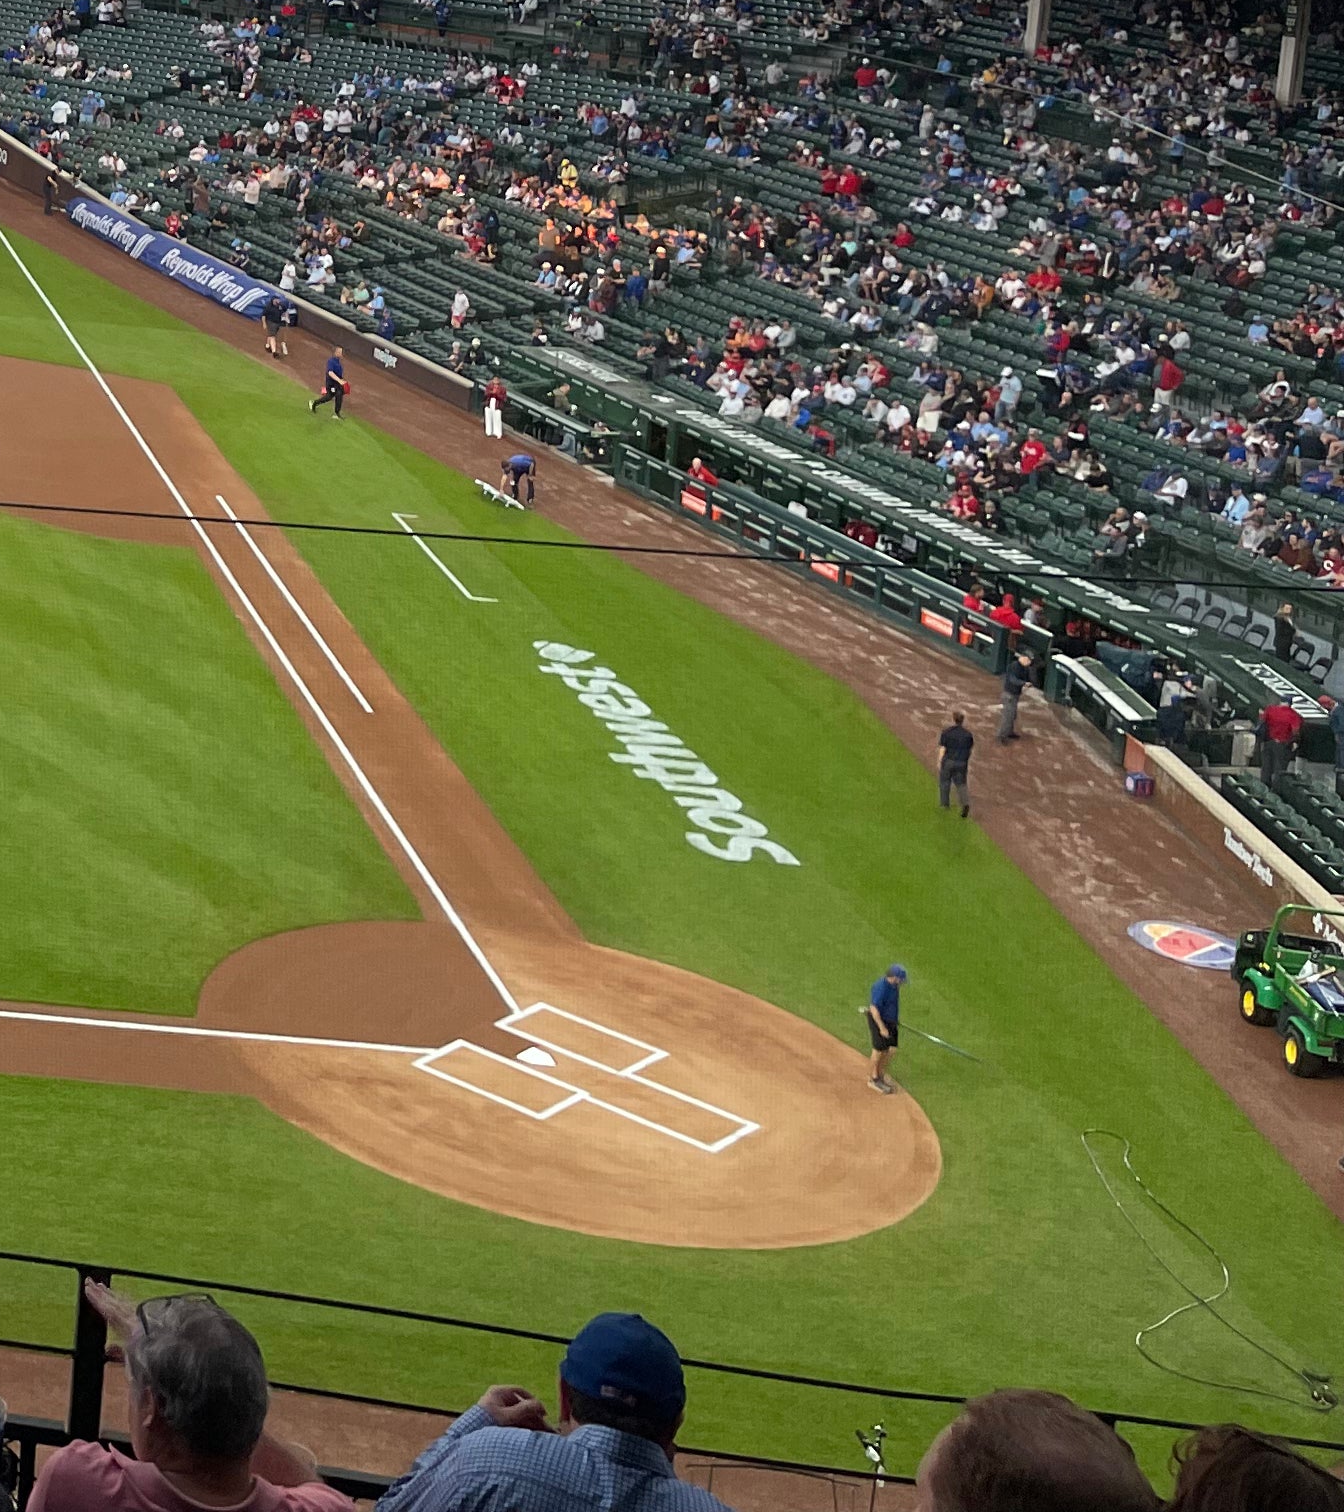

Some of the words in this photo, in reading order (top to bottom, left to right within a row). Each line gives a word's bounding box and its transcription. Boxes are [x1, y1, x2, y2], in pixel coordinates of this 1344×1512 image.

[70, 202, 113, 237] Reynolds
[108, 220, 137, 252] Wrap
[160, 247, 213, 288] Reynolds
[211, 271, 244, 302] Wrap
[538, 662, 802, 867] Southwest
